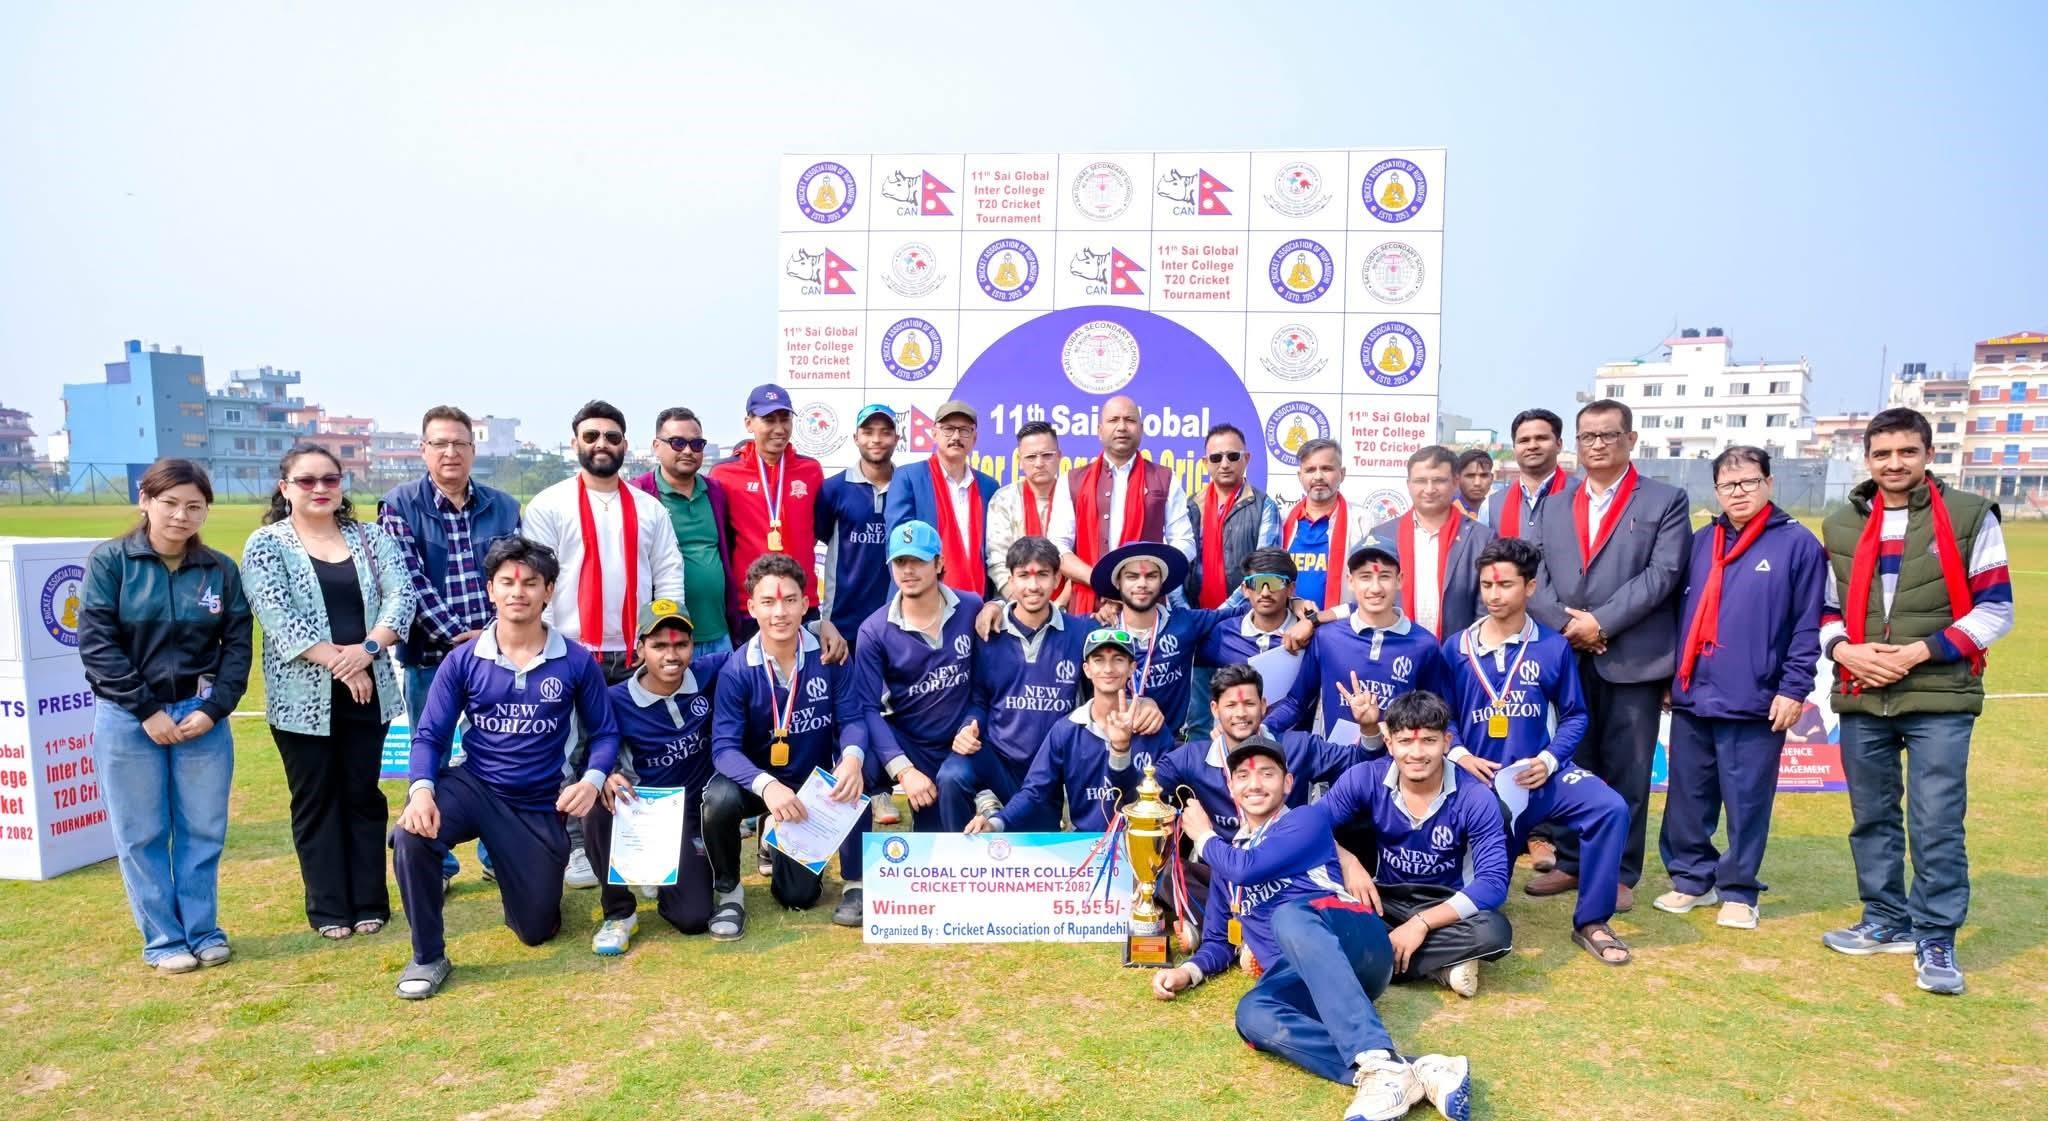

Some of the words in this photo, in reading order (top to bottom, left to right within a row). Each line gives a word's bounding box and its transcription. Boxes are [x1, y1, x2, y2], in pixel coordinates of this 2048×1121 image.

[972, 172, 990, 180] 11th
[994, 172, 1010, 180] Sai
[1015, 171, 1049, 180] Global
[1364, 176, 1373, 202] CRICKET
[1371, 160, 1405, 175] ASSOCIATION
[1406, 163, 1414, 172] OF
[974, 186, 1000, 194] Inter
[1004, 186, 1045, 197] College
[978, 200, 997, 208] T20
[1002, 200, 1040, 208] Cricket
[897, 207, 918, 216] CAN
[1173, 207, 1194, 216] CAN
[1396, 210, 1410, 220] 2053
[976, 214, 1041, 223] Tournament
[984, 241, 1018, 258] ASSOCIATION
[1018, 244, 1026, 252] OF
[1159, 246, 1178, 256] 11th
[1182, 246, 1198, 256] Sai
[1203, 246, 1238, 256] Global
[1381, 244, 1416, 258] SECONDARY
[1162, 260, 1188, 270] Inter
[1192, 260, 1234, 272] College
[1272, 256, 1280, 283] CRICKET
[1278, 241, 1312, 256] ASSOCIATION
[1313, 244, 1322, 254] OF
[1165, 275, 1185, 284] T20
[1190, 275, 1230, 284] Cricket
[801, 286, 822, 295] CAN
[1086, 286, 1107, 296] CAN
[1163, 290, 1230, 300] Tournament
[1302, 292, 1316, 301] 2053
[784, 328, 802, 336] 11th
[805, 328, 820, 336] Sai
[824, 327, 858, 336] Global
[787, 341, 811, 350] Inter
[815, 341, 854, 352] College
[883, 336, 892, 362] CRICKET
[888, 320, 923, 338] ASSOCIATION
[923, 323, 931, 332] OF
[1084, 322, 1130, 340] SECONDARY
[1128, 340, 1137, 371] SCHOOL
[1362, 340, 1371, 367] CRICKET
[1370, 323, 1405, 341] ASSOCIATION
[1404, 327, 1414, 336] OF
[790, 356, 808, 365] T20
[812, 356, 850, 365] Cricket
[789, 370, 850, 380] Tournament
[1393, 375, 1408, 384] 2053
[1274, 403, 1309, 421] ASSOCIATION
[1310, 406, 1318, 415] OF
[1348, 412, 1368, 422] 11th
[1372, 412, 1390, 422] Sai
[1394, 412, 1430, 423] Global
[990, 404, 1045, 434] 11th
[1052, 404, 1098, 436] Sai
[1138, 405, 1209, 438] obal
[1352, 426, 1378, 436] Inter
[1383, 427, 1424, 440] College
[1355, 442, 1376, 452] T20
[1380, 442, 1420, 452] Cricket
[1354, 456, 1408, 466] Tournam
[866, 522, 886, 534] NE
[850, 532, 885, 544] HORIZ
[1290, 553, 1328, 571] EPA
[47, 568, 82, 593] ASSOCIATION
[43, 596, 52, 624] CRICKET
[928, 664, 961, 680] NEW
[1024, 684, 1061, 699] NEW
[1359, 680, 1396, 697] NEW
[38, 691, 94, 716] PRESE
[1006, 696, 1073, 712] HORIZON
[496, 704, 539, 718] NEW
[792, 706, 816, 723] EW
[474, 713, 558, 734] HORIZON
[46, 739, 66, 756] 11th
[68, 734, 86, 751] Sai
[1781, 748, 1813, 756] IENCE
[46, 761, 77, 784] Inter
[54, 788, 76, 810] T20
[7, 827, 33, 840] 2082
[1400, 847, 1440, 866] NEW
[880, 867, 899, 878] SAI
[904, 867, 956, 878] GLOBAL
[960, 867, 987, 878] CUP
[992, 867, 1030, 878] INTER
[1034, 867, 1094, 878] COLLEGE
[911, 882, 966, 892] CRICKET
[968, 882, 1091, 892] TOURNAMENT-2082
[873, 900, 936, 914] Winner
[1053, 900, 1125, 916] 55,555/-
[871, 924, 918, 938] Organized
[922, 925, 933, 938] By
[944, 923, 984, 936] Cricket
[986, 922, 1050, 936] Association
[1054, 922, 1064, 936] of
[1068, 922, 1126, 938] Rupandehi
